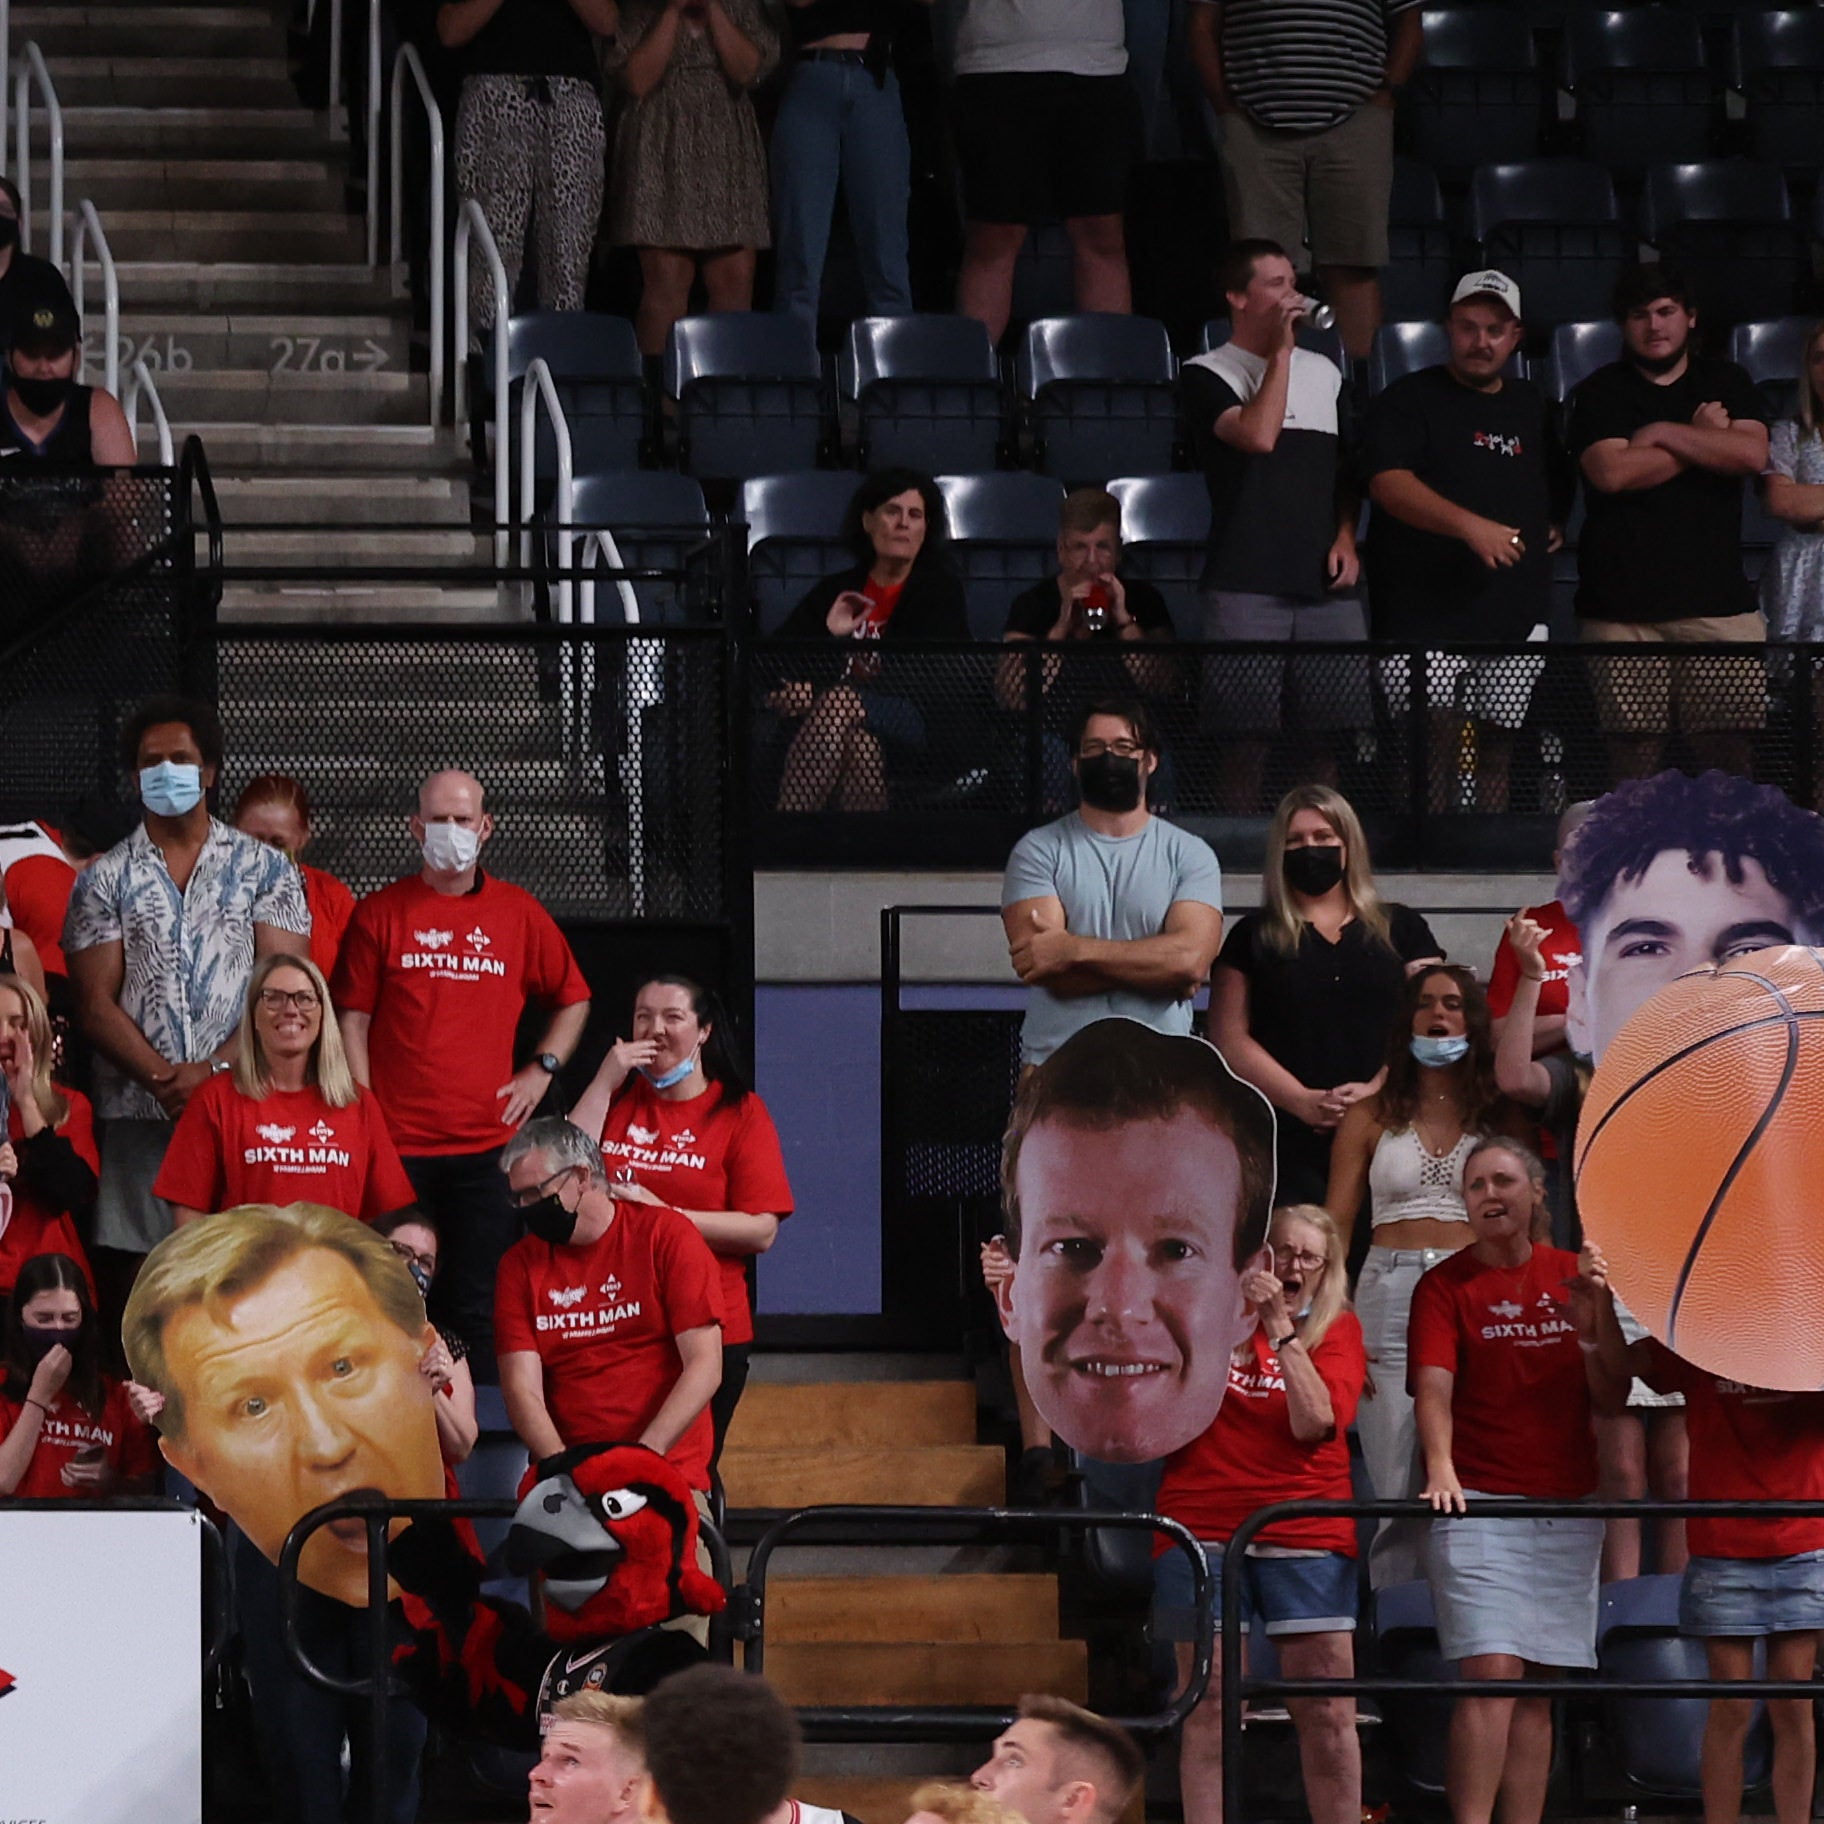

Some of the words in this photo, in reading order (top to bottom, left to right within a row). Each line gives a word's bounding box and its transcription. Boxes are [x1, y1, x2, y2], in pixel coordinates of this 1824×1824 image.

[401, 953, 459, 970] SIXTH
[463, 956, 505, 976] MAN
[244, 1146, 304, 1164] SIXTH
[309, 1149, 350, 1167] MAN
[601, 1140, 657, 1163] SIXTH
[660, 1150, 706, 1170] MAN
[536, 1311, 595, 1332] SIXTH
[599, 1301, 642, 1324] MAN
[1481, 1323, 1537, 1341] SIXTH
[1539, 1319, 1577, 1337] MA
[1261, 1374, 1287, 1392] MA
[74, 1422, 114, 1447] MAN
